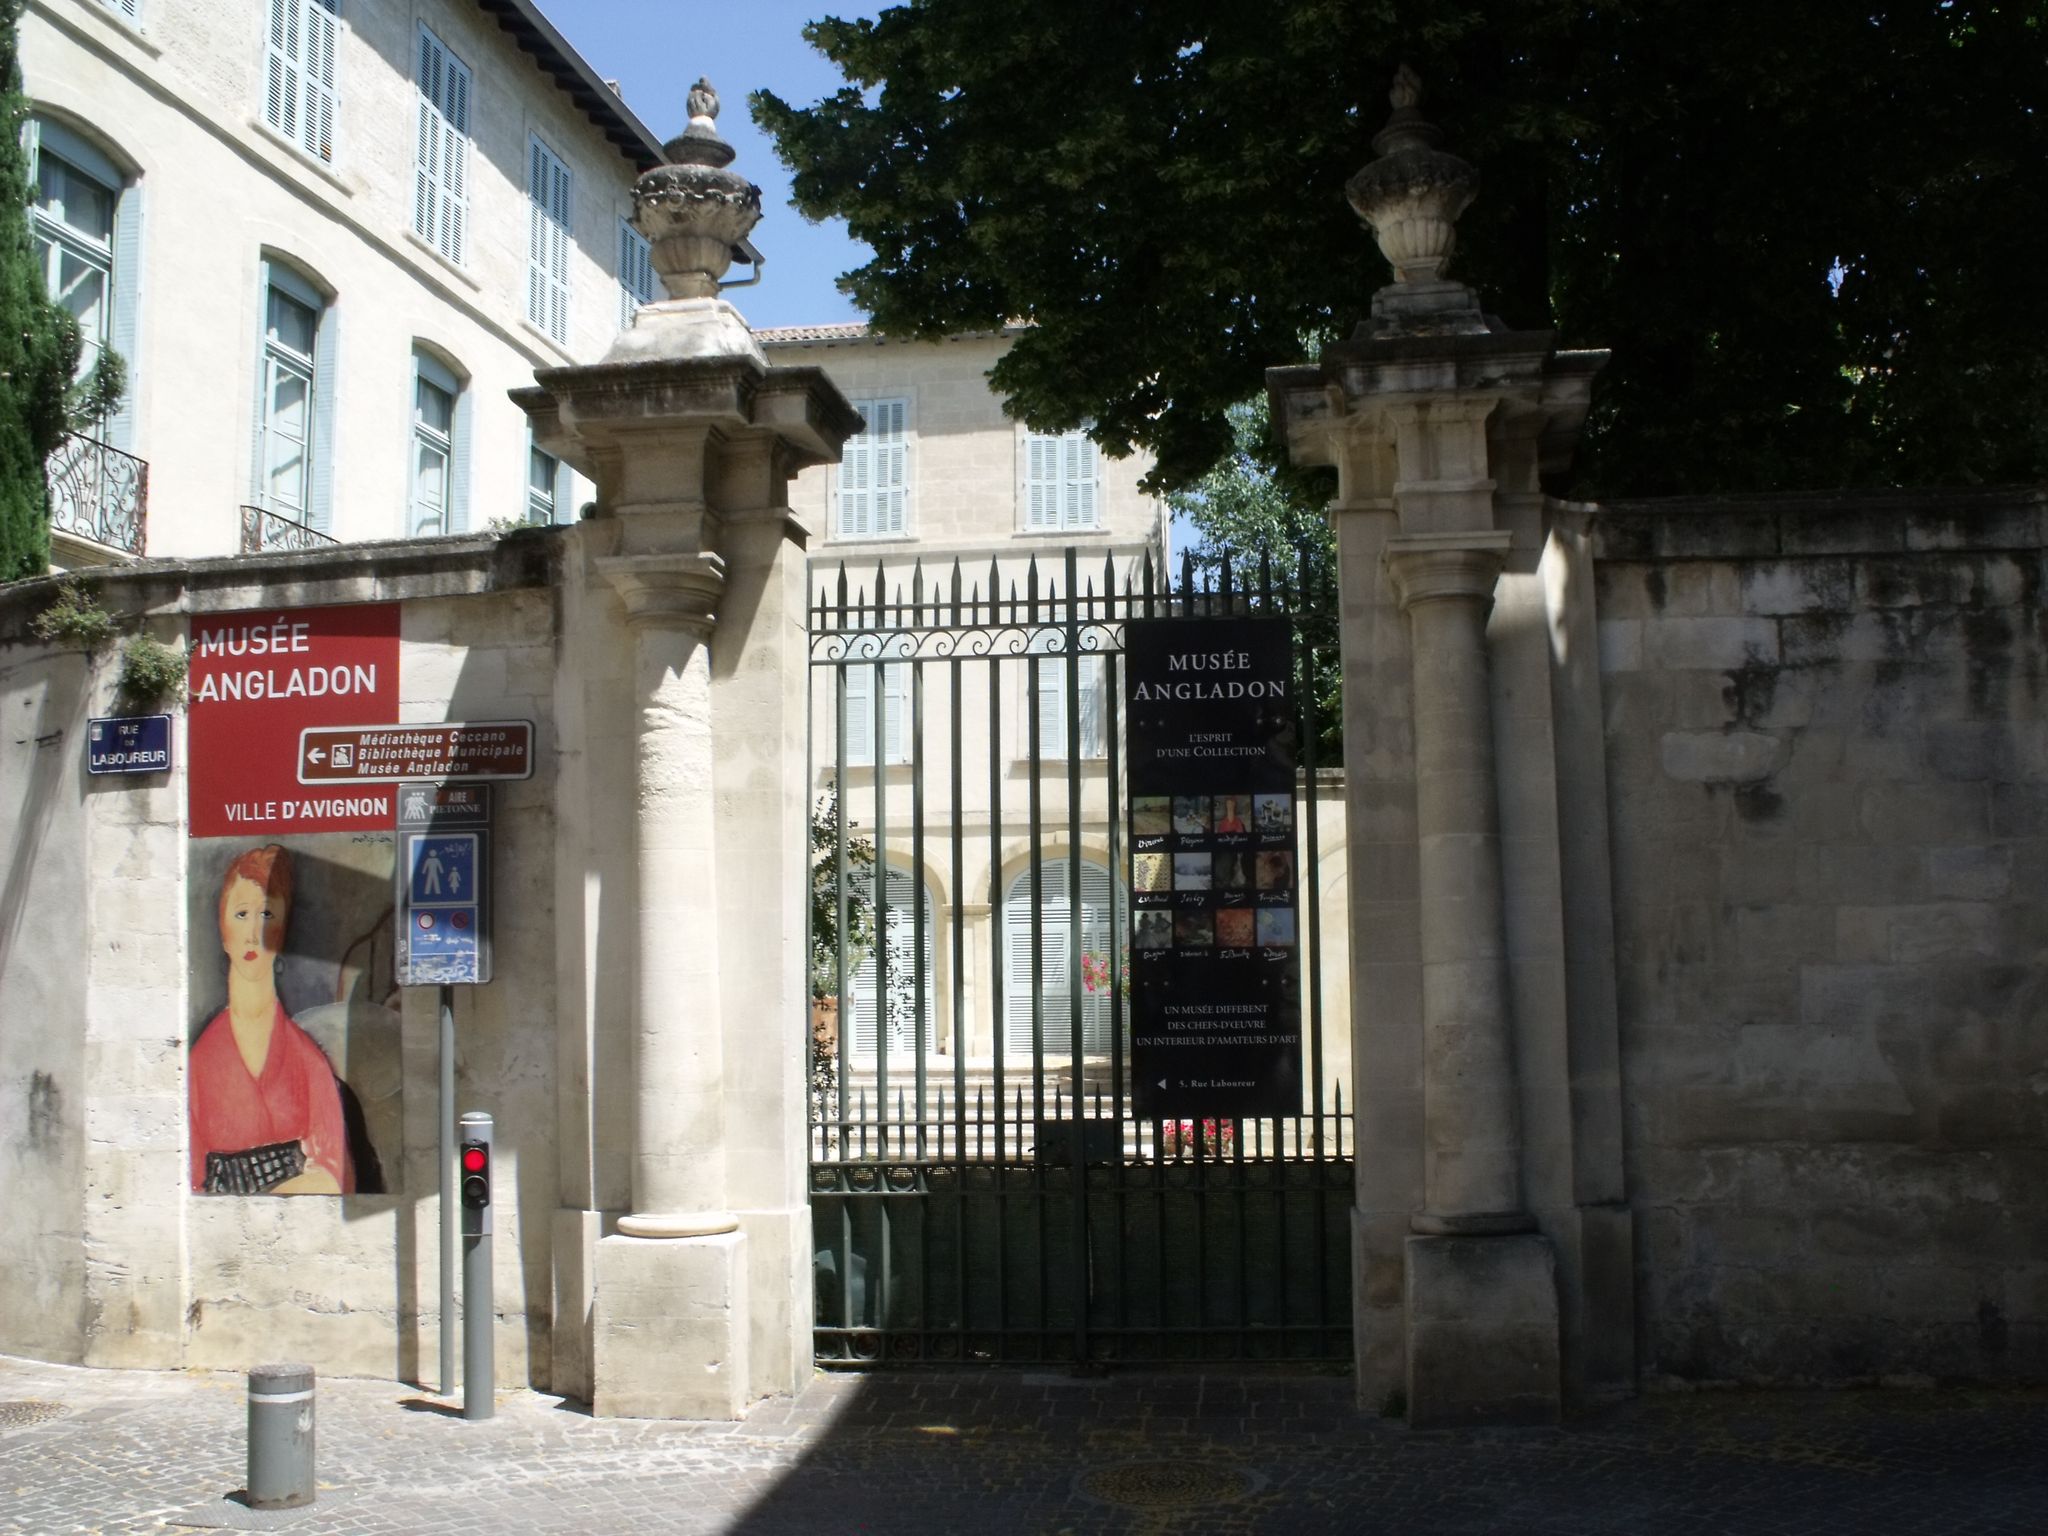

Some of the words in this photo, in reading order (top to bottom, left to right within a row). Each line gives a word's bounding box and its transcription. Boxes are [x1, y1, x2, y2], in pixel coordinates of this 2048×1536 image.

[200, 616, 310, 658] MUSÉE
[1168, 649, 1251, 671] MUSÉE
[198, 664, 376, 703] ANGLADON
[1133, 680, 1286, 701] ANGLADON
[118, 725, 139, 735] RUE
[359, 733, 443, 747] Médiathèque
[449, 731, 506, 743] Ceccano
[1188, 733, 1233, 743] L'ESPRIT
[92, 750, 166, 766] LABOUREUR
[358, 749, 441, 761] Bibliothèque
[447, 744, 524, 759] Municipale
[1156, 748, 1190, 758] D'UNE
[1193, 746, 1266, 758] COLLECTION
[357, 763, 400, 775] Musée
[406, 761, 469, 776] Angladon
[225, 802, 277, 822] VILLE
[282, 797, 388, 819] D'AVIGNON
[1164, 1006, 1179, 1014] UN
[1181, 1004, 1214, 1014] MUSÉE
[1215, 1004, 1269, 1014] DIFFERENT
[1167, 1021, 1186, 1030] DES
[1136, 1037, 1152, 1046] UN
[1153, 1036, 1205, 1046] INTERIEUR
[1207, 1034, 1267, 1045] D'AMATEURS
[1269, 1034, 1298, 1044] D'ART
[1191, 1080, 1208, 1088] Rue
[1211, 1079, 1256, 1088] Laboureur
